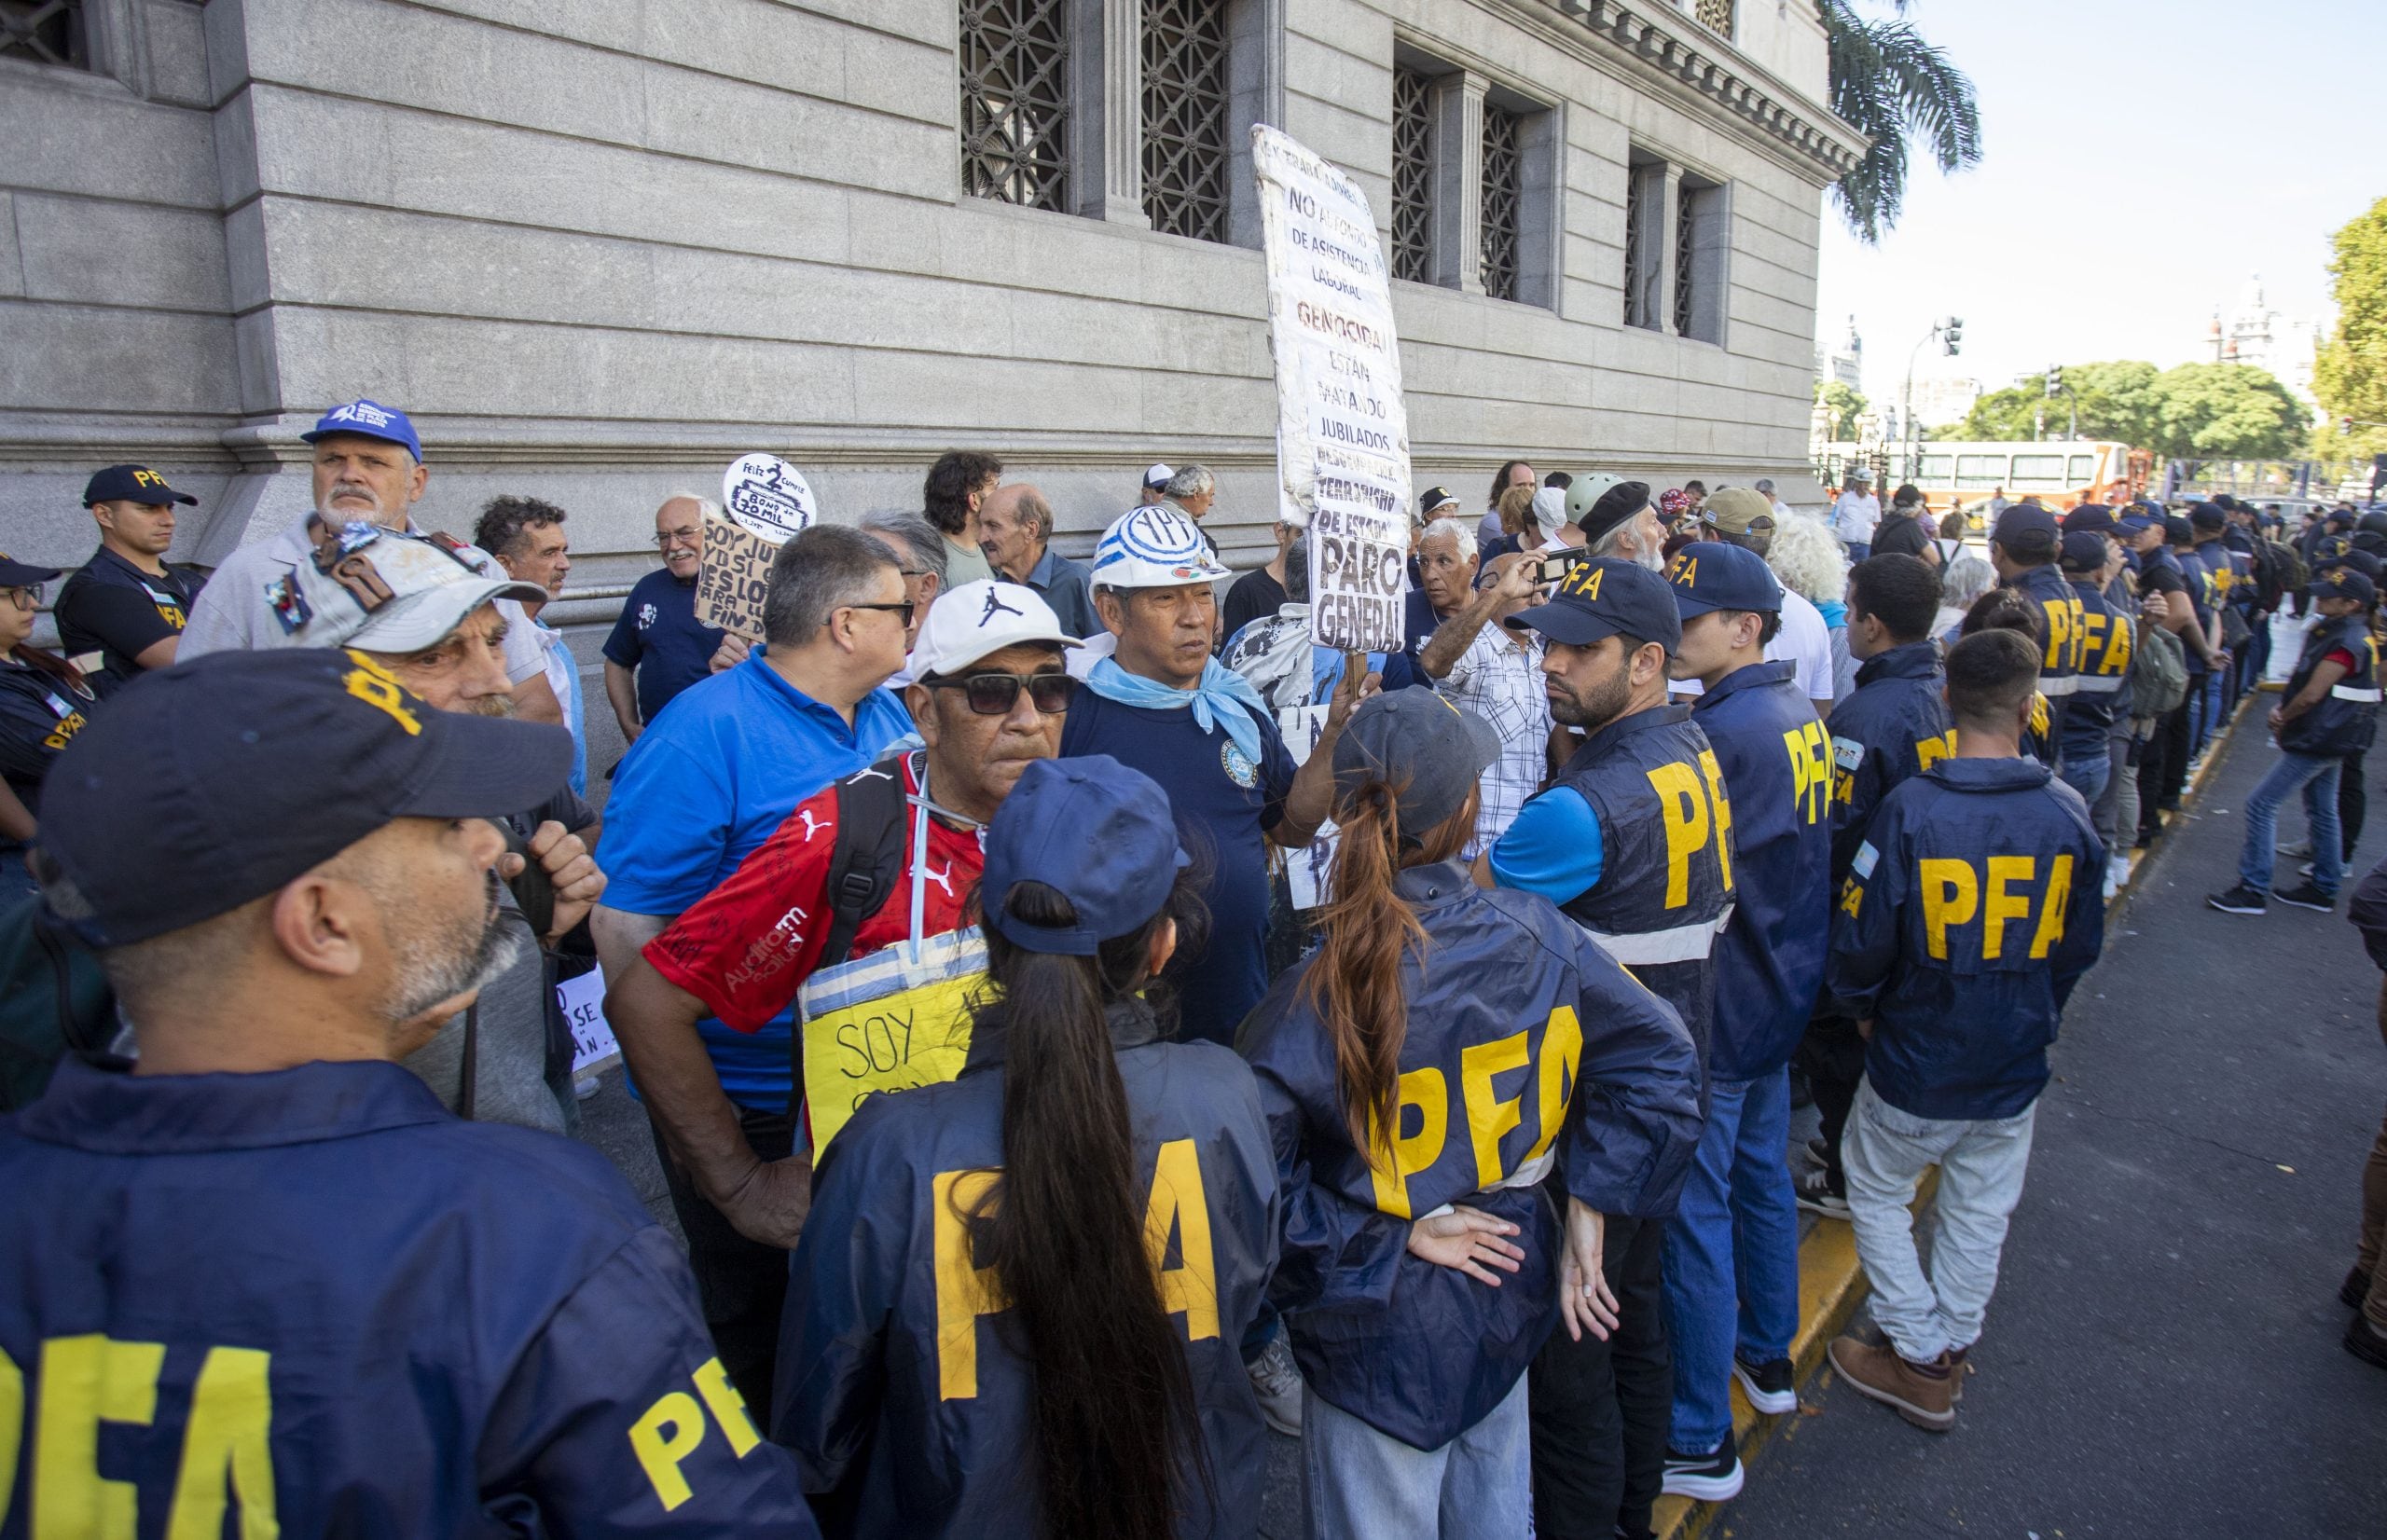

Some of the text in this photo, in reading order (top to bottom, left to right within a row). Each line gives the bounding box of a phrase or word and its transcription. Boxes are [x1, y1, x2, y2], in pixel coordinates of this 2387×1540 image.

[1289, 186, 1316, 218] NO
[1292, 227, 1309, 250] DE
[1311, 236, 1371, 278] ASISTENCIA
[1311, 265, 1362, 301] LABORAL
[1320, 417, 1391, 452] JUBILADOS
[705, 518, 747, 551] SOY
[761, 509, 783, 524] MIL
[1136, 507, 1192, 546] YPF
[1318, 509, 1342, 533] DE
[1319, 536, 1402, 597] PARO
[698, 584, 737, 610] ARA
[1317, 593, 1403, 653] GENERAL
[1783, 718, 1835, 825] PFA
[1919, 854, 2074, 960] PFA
[836, 1008, 914, 1079] SOY
[1369, 1005, 1584, 1220] PFA
[0, 1333, 280, 1540] FA
